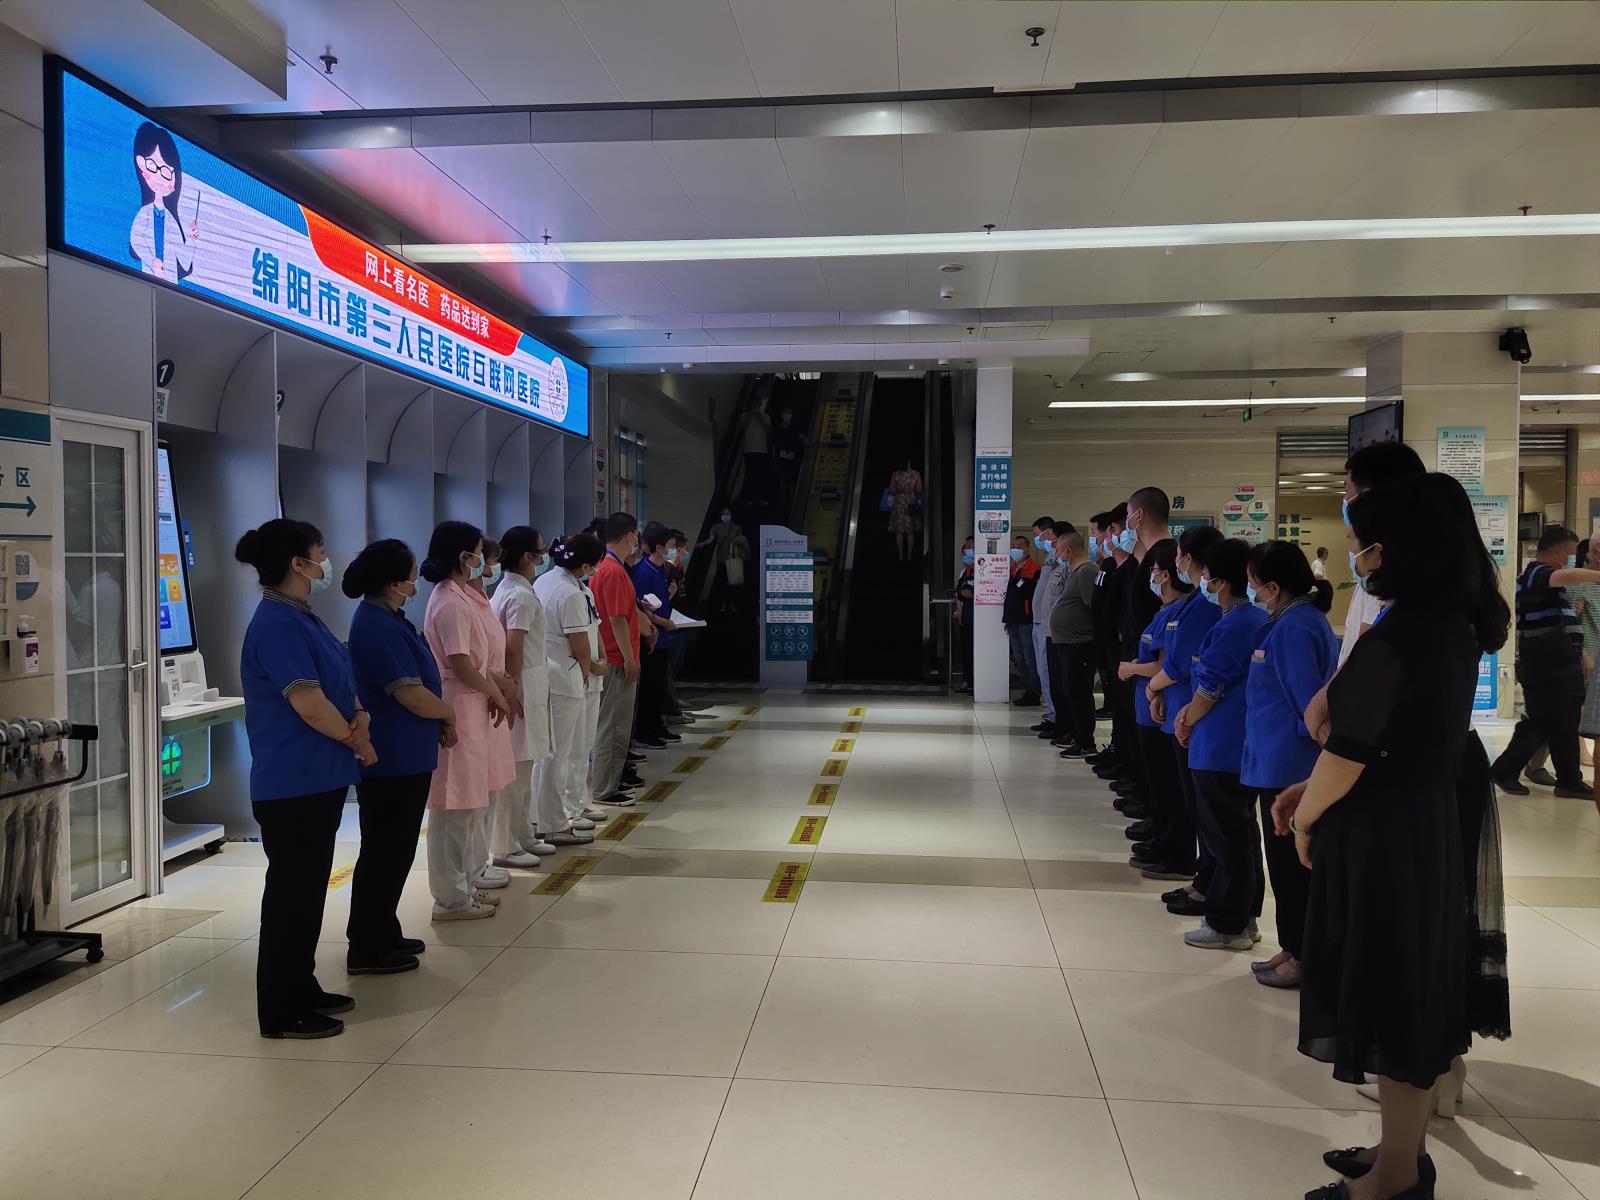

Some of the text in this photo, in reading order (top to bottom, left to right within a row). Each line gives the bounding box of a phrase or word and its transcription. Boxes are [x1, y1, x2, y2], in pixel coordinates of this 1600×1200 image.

[364, 250, 490, 339] 网上看名医 药品送到家
[252, 247, 540, 409] 绵阳市第三人民医院互联网医院
[159, 364, 169, 383] 1
[1172, 496, 1185, 509] 房
